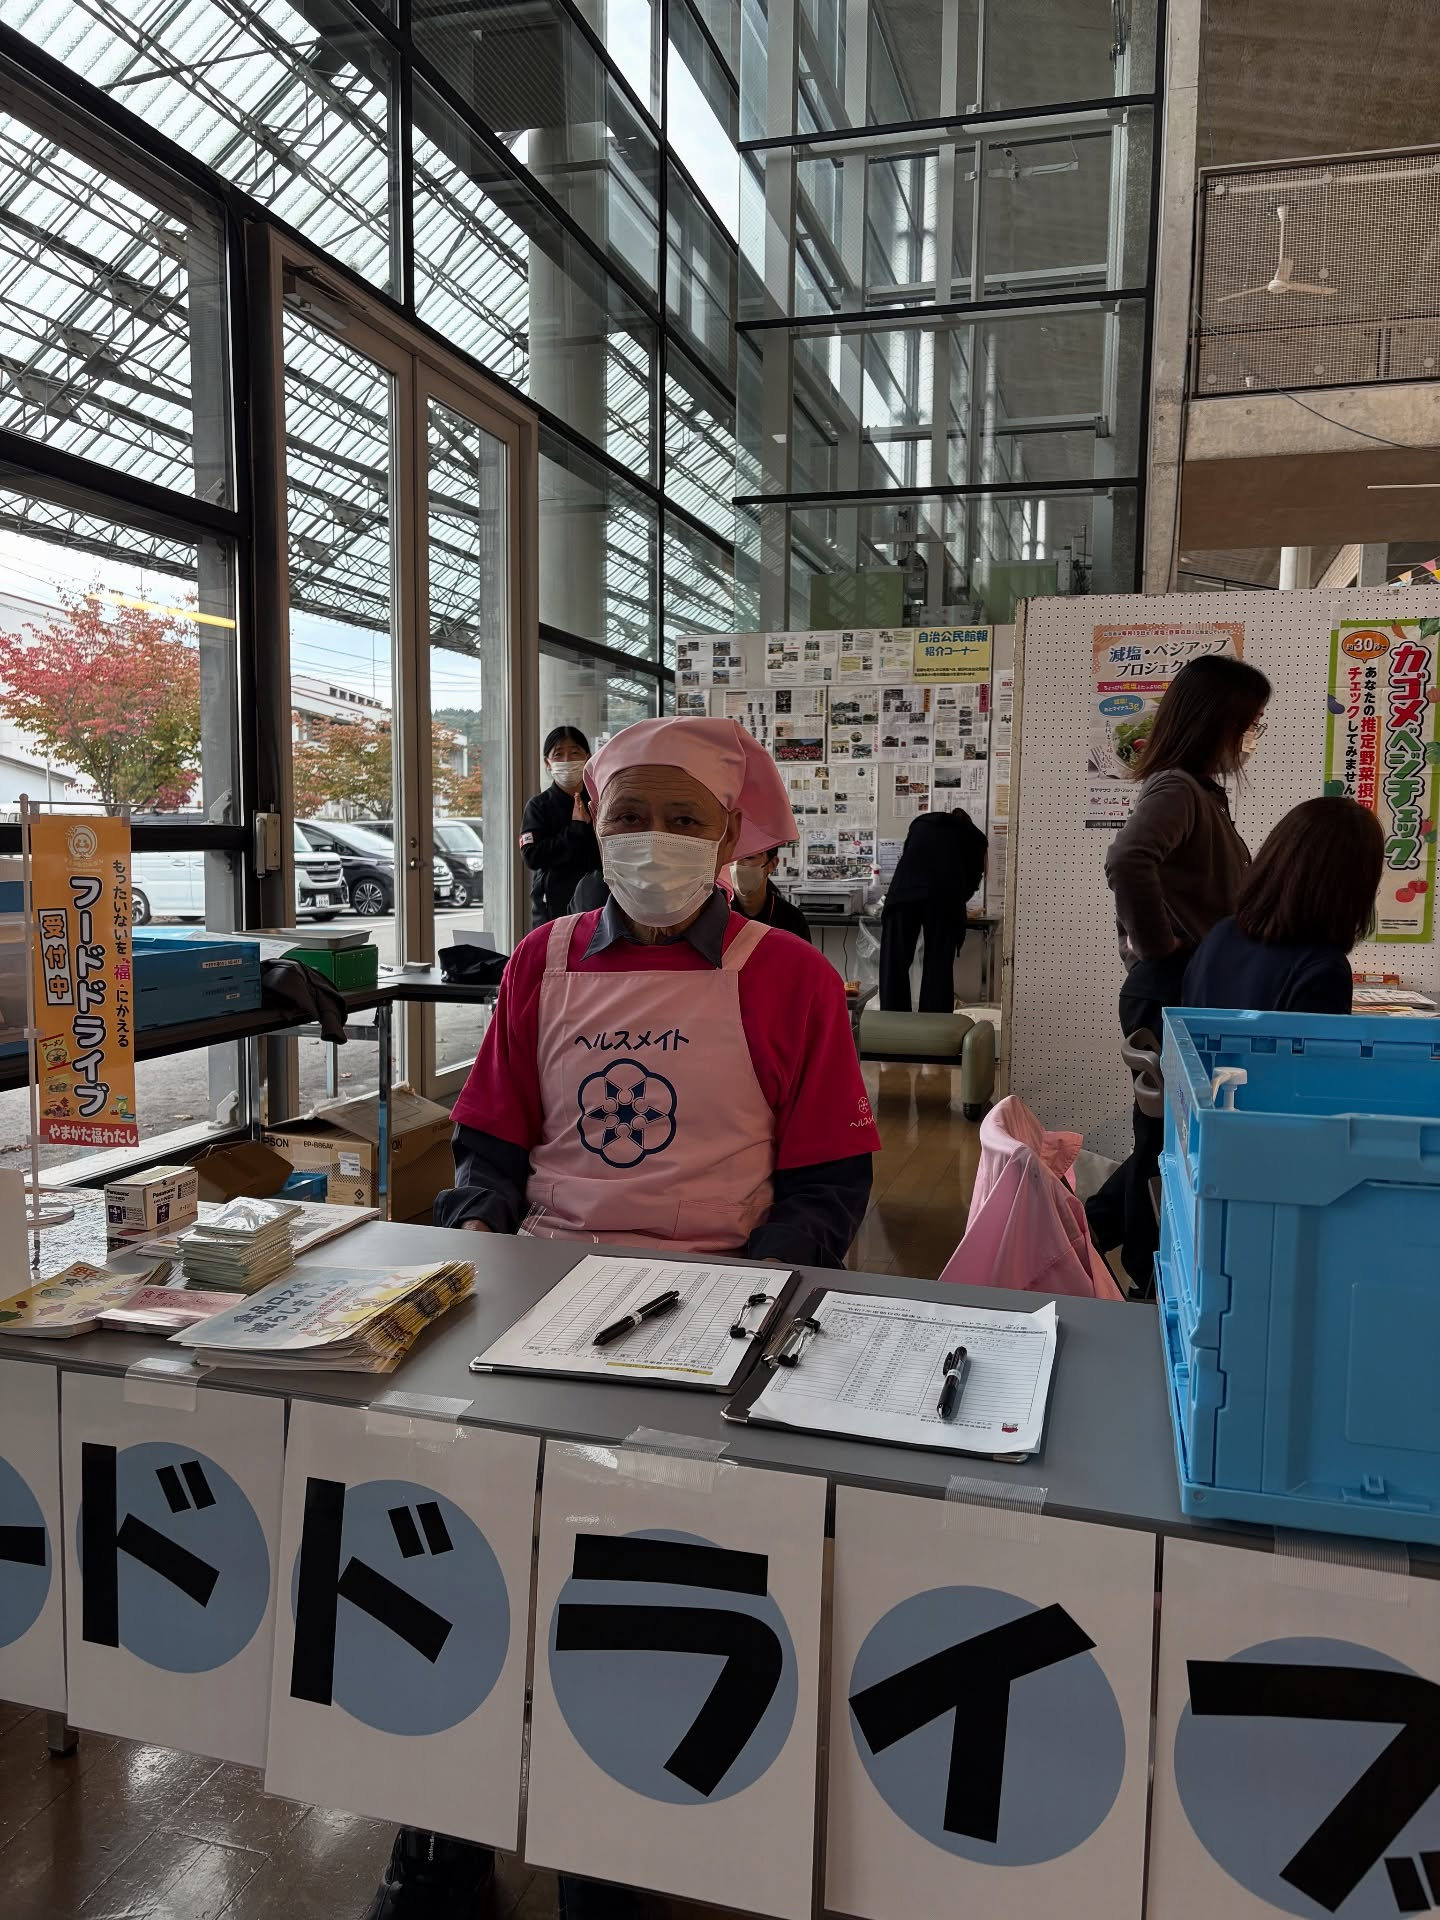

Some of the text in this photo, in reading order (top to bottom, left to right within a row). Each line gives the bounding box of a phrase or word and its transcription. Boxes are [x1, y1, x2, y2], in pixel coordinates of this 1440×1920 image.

[918, 630, 988, 643] 自治公民館報
[925, 646, 979, 656] 紹介コーナー
[1109, 637, 1231, 662] 減塩・ベジアップ
[1344, 667, 1362, 799] チェックしてみません
[42, 914, 69, 1000] 受付中
[113, 860, 131, 1047] もったいないを福にかえる
[69, 875, 109, 1118] フードドライブ
[42, 1040, 64, 1050] ラーメン
[574, 1029, 689, 1051] ヘルスメイト
[850, 1115, 874, 1127] ヘルスメ
[49, 1123, 137, 1145] やまがた福わたし
[262, 1137, 289, 1148] PSON
